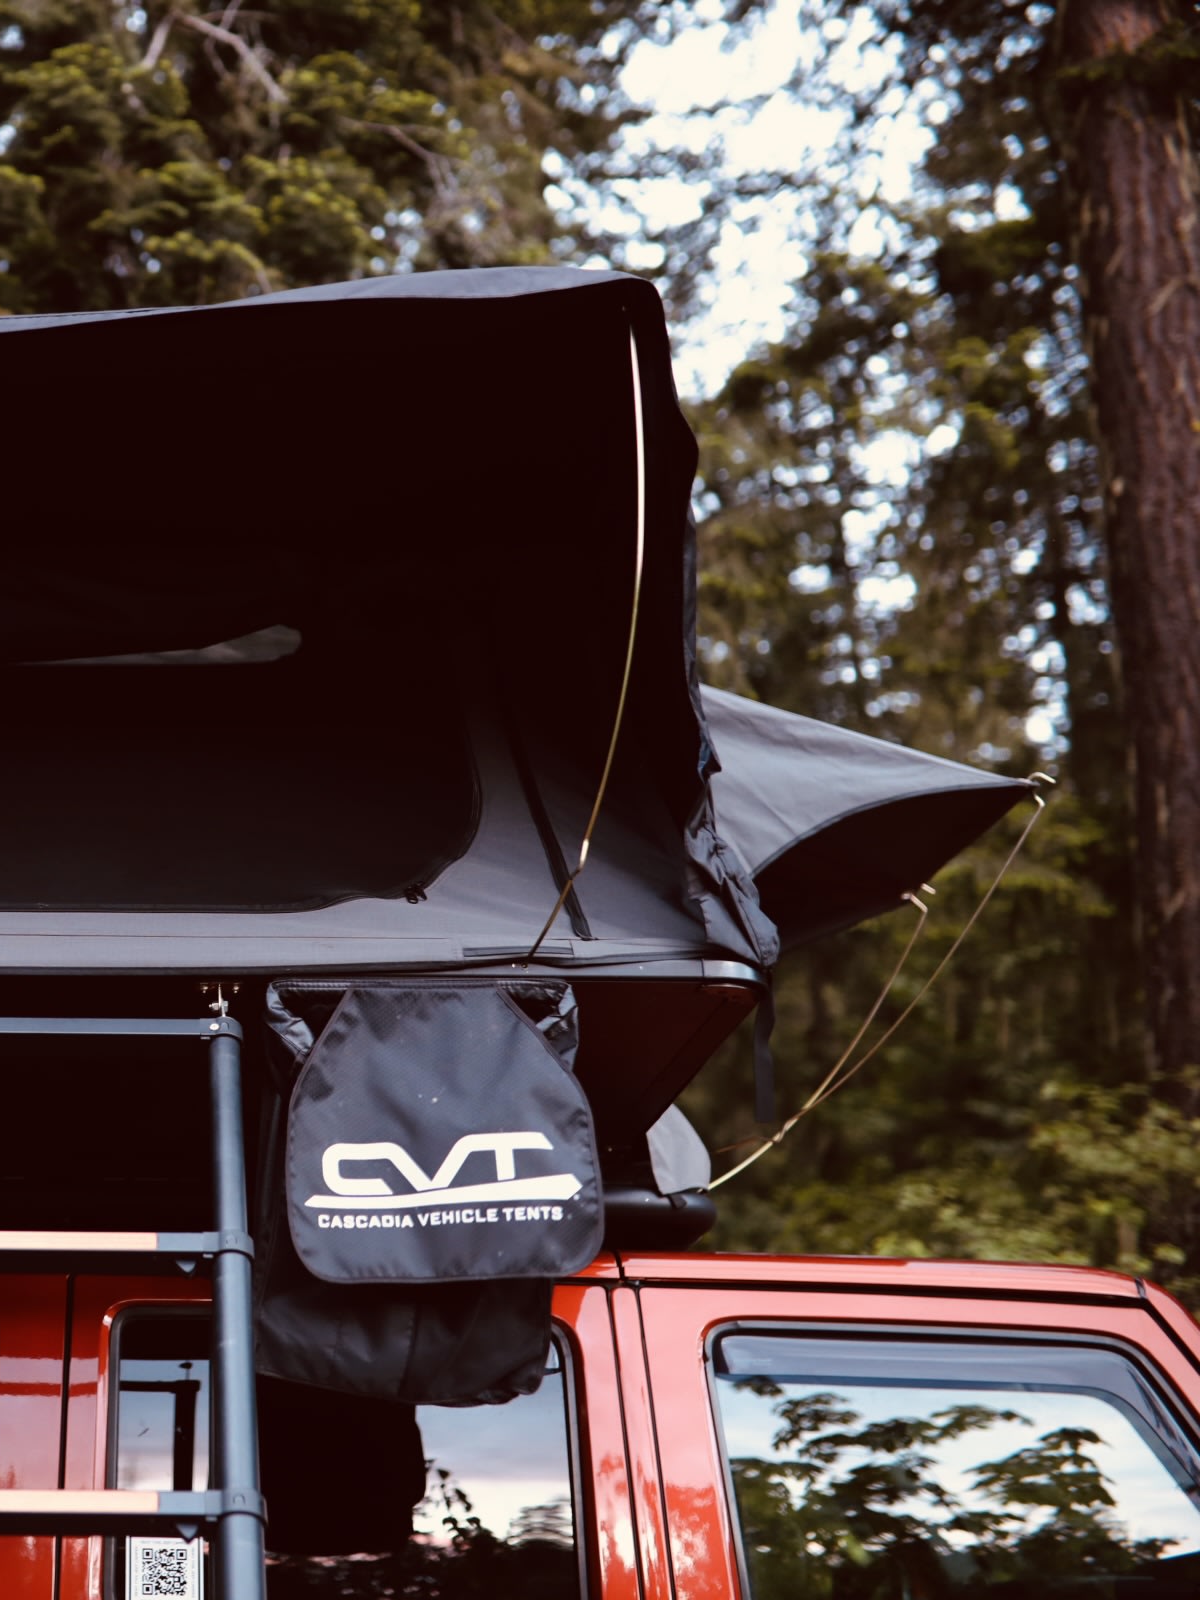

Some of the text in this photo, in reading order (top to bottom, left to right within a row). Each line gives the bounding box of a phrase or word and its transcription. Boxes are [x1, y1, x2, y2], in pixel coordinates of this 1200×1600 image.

[321, 1131, 554, 1196] CVT
[317, 1206, 563, 1229] CASCADIA VEHICLE TENTS
